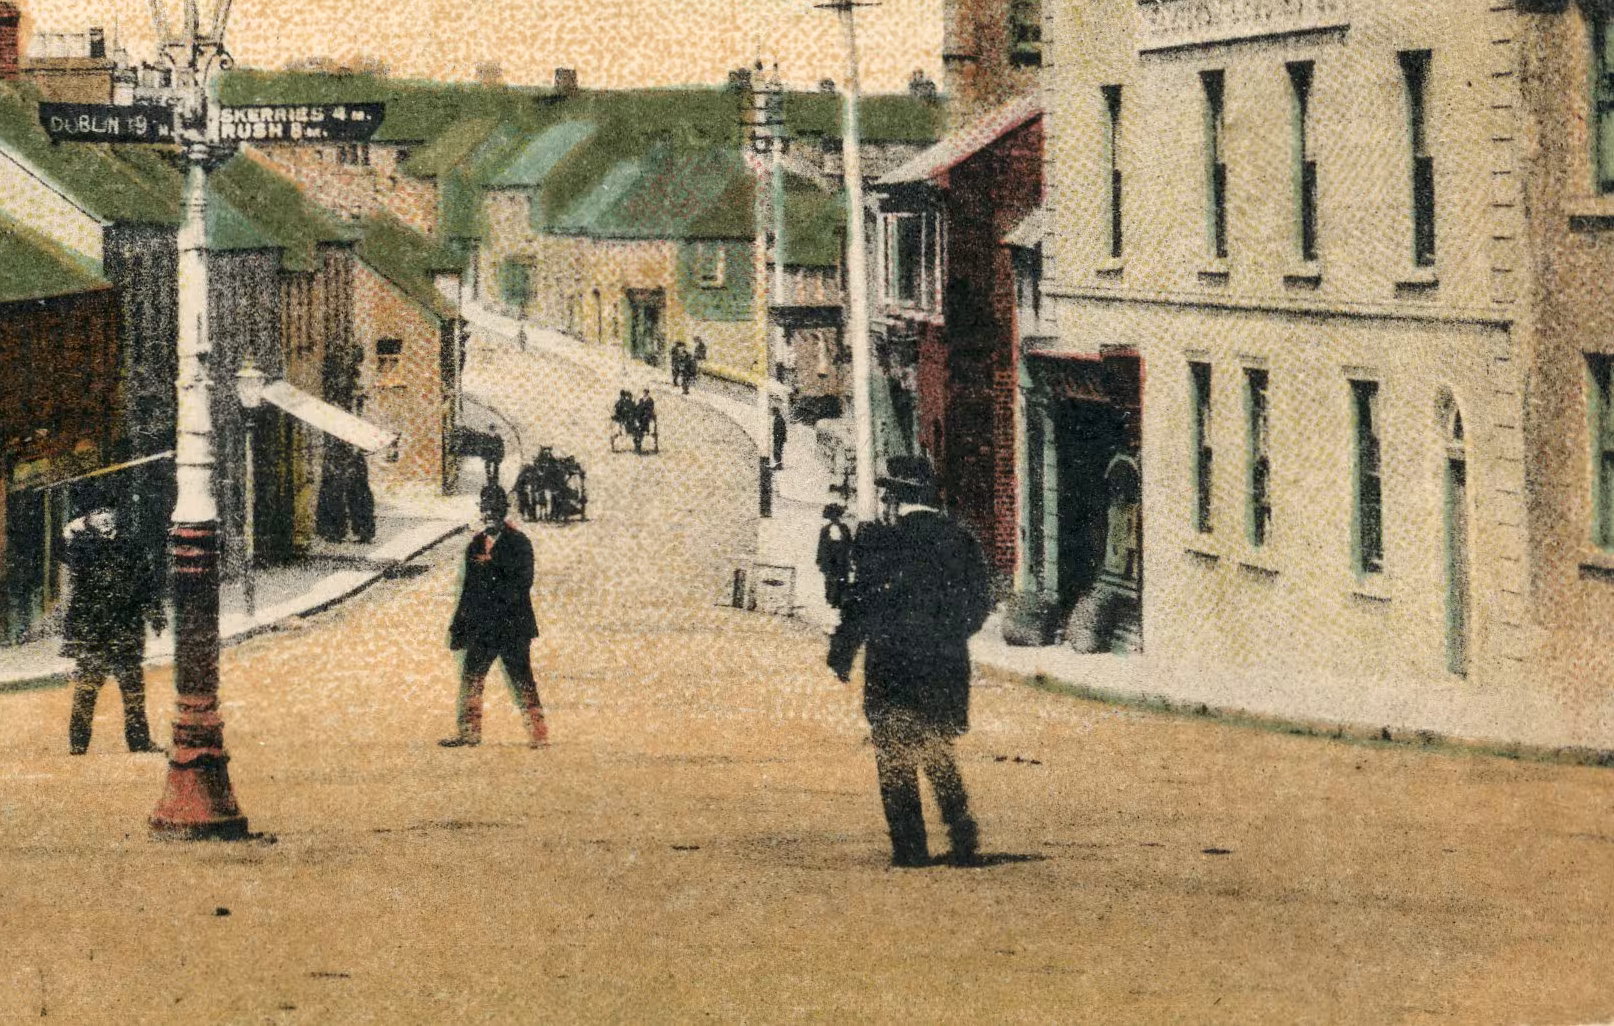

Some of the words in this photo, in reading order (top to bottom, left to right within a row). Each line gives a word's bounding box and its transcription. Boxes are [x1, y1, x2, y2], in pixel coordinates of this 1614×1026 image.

[220, 106, 325, 123] SKERRIES
[332, 106, 346, 121] 4
[50, 114, 119, 135] DUBLIN
[221, 123, 283, 139] RUSH
